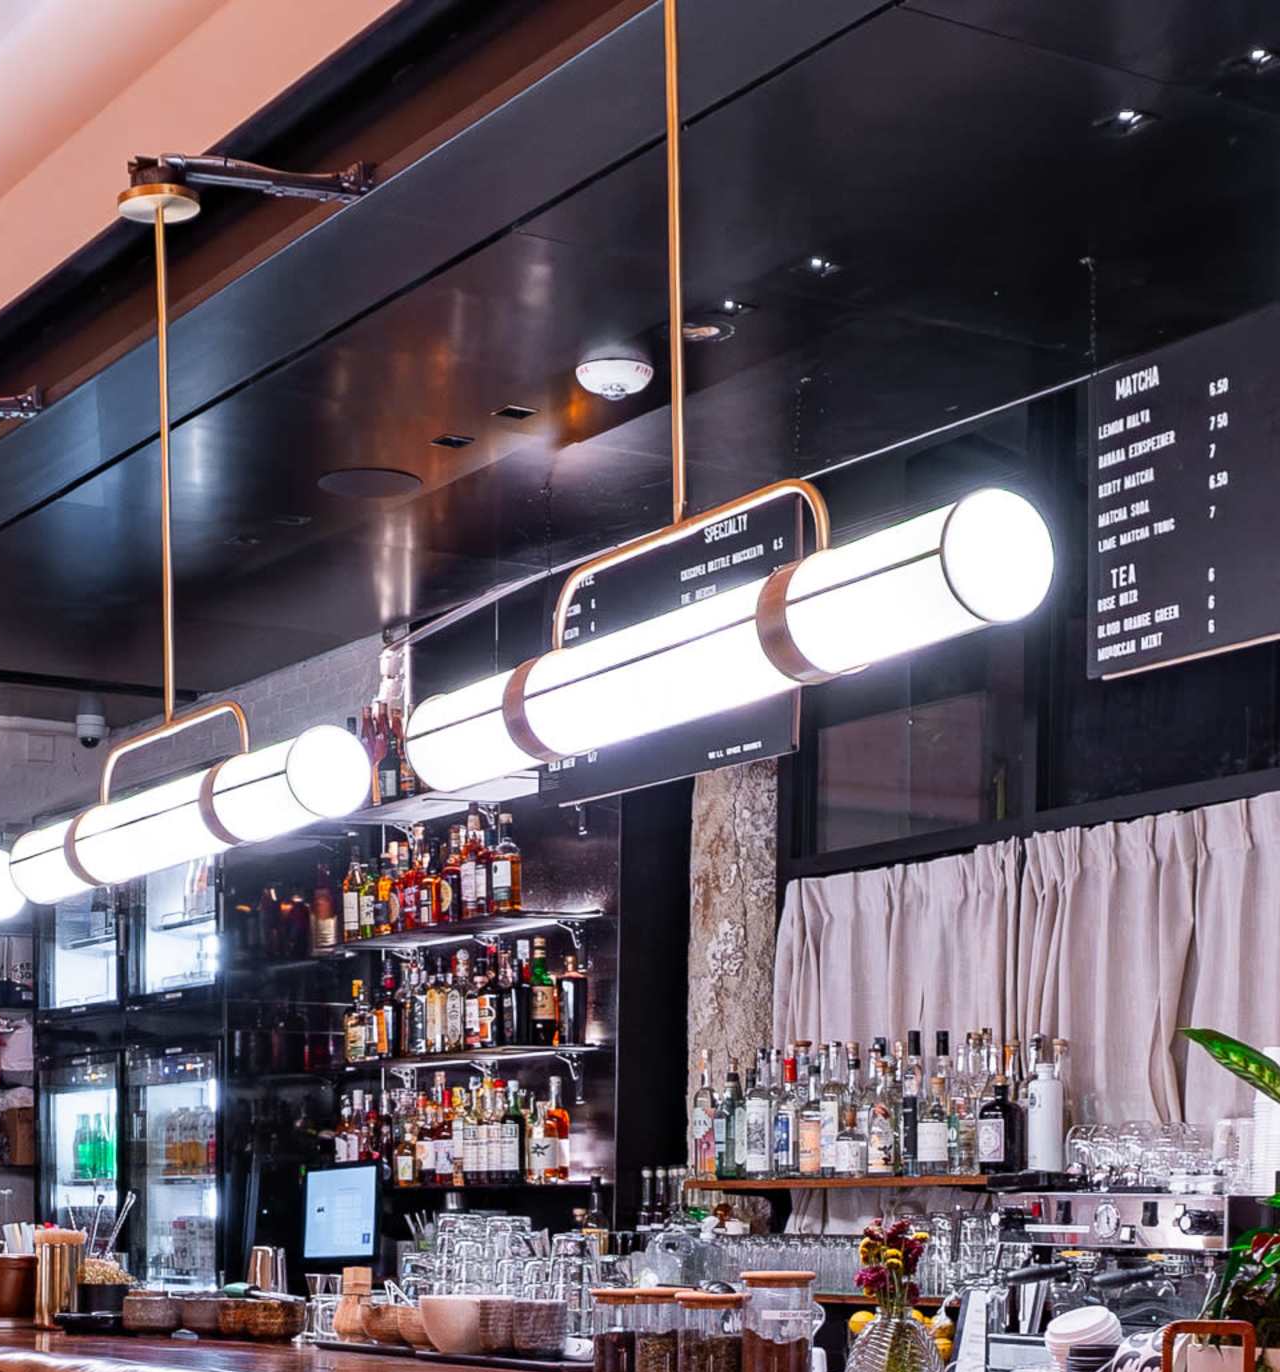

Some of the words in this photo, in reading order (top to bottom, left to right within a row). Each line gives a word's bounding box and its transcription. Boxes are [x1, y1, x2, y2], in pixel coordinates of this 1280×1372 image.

[1116, 365, 1160, 400] MATCHA
[1098, 418, 1124, 440] LEMON
[1209, 377, 1229, 396] 6.50
[1123, 467, 1154, 490] MATCHA
[1098, 506, 1128, 529] MATCHA
[1209, 471, 1229, 490] 6.50
[704, 513, 748, 544] SPECIALTY
[1120, 526, 1150, 546] MATCHA
[1110, 563, 1136, 589] TEA
[1208, 567, 1215, 582] 6
[1208, 595, 1215, 609] 6
[1140, 632, 1163, 650] MINT
[1208, 619, 1215, 633] 6
